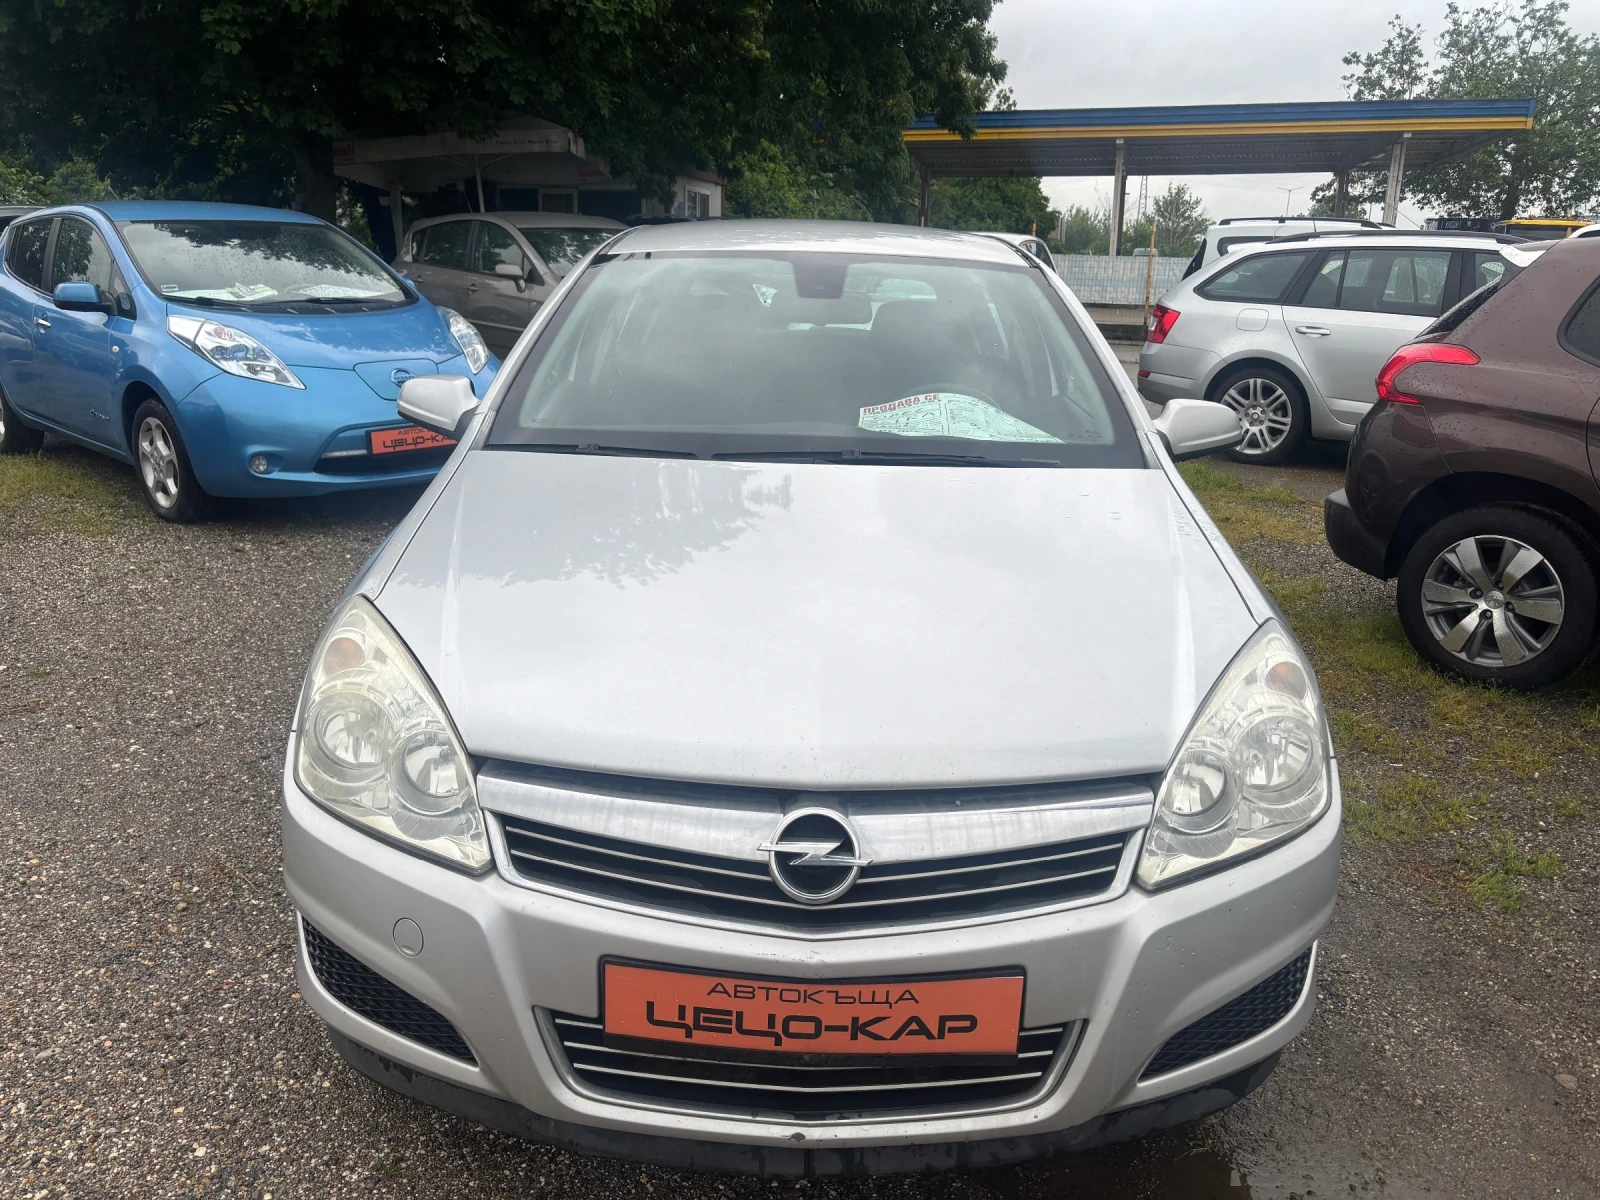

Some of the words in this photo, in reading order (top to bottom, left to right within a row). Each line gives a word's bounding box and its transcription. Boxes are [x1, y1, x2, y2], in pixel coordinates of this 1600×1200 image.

[863, 396, 921, 414] ПРОДАВА
[398, 427, 432, 436] АВТОК
[706, 982, 920, 1009] АВТОКЪЩА
[646, 1000, 979, 1047] ЦЕЦО-КАР
